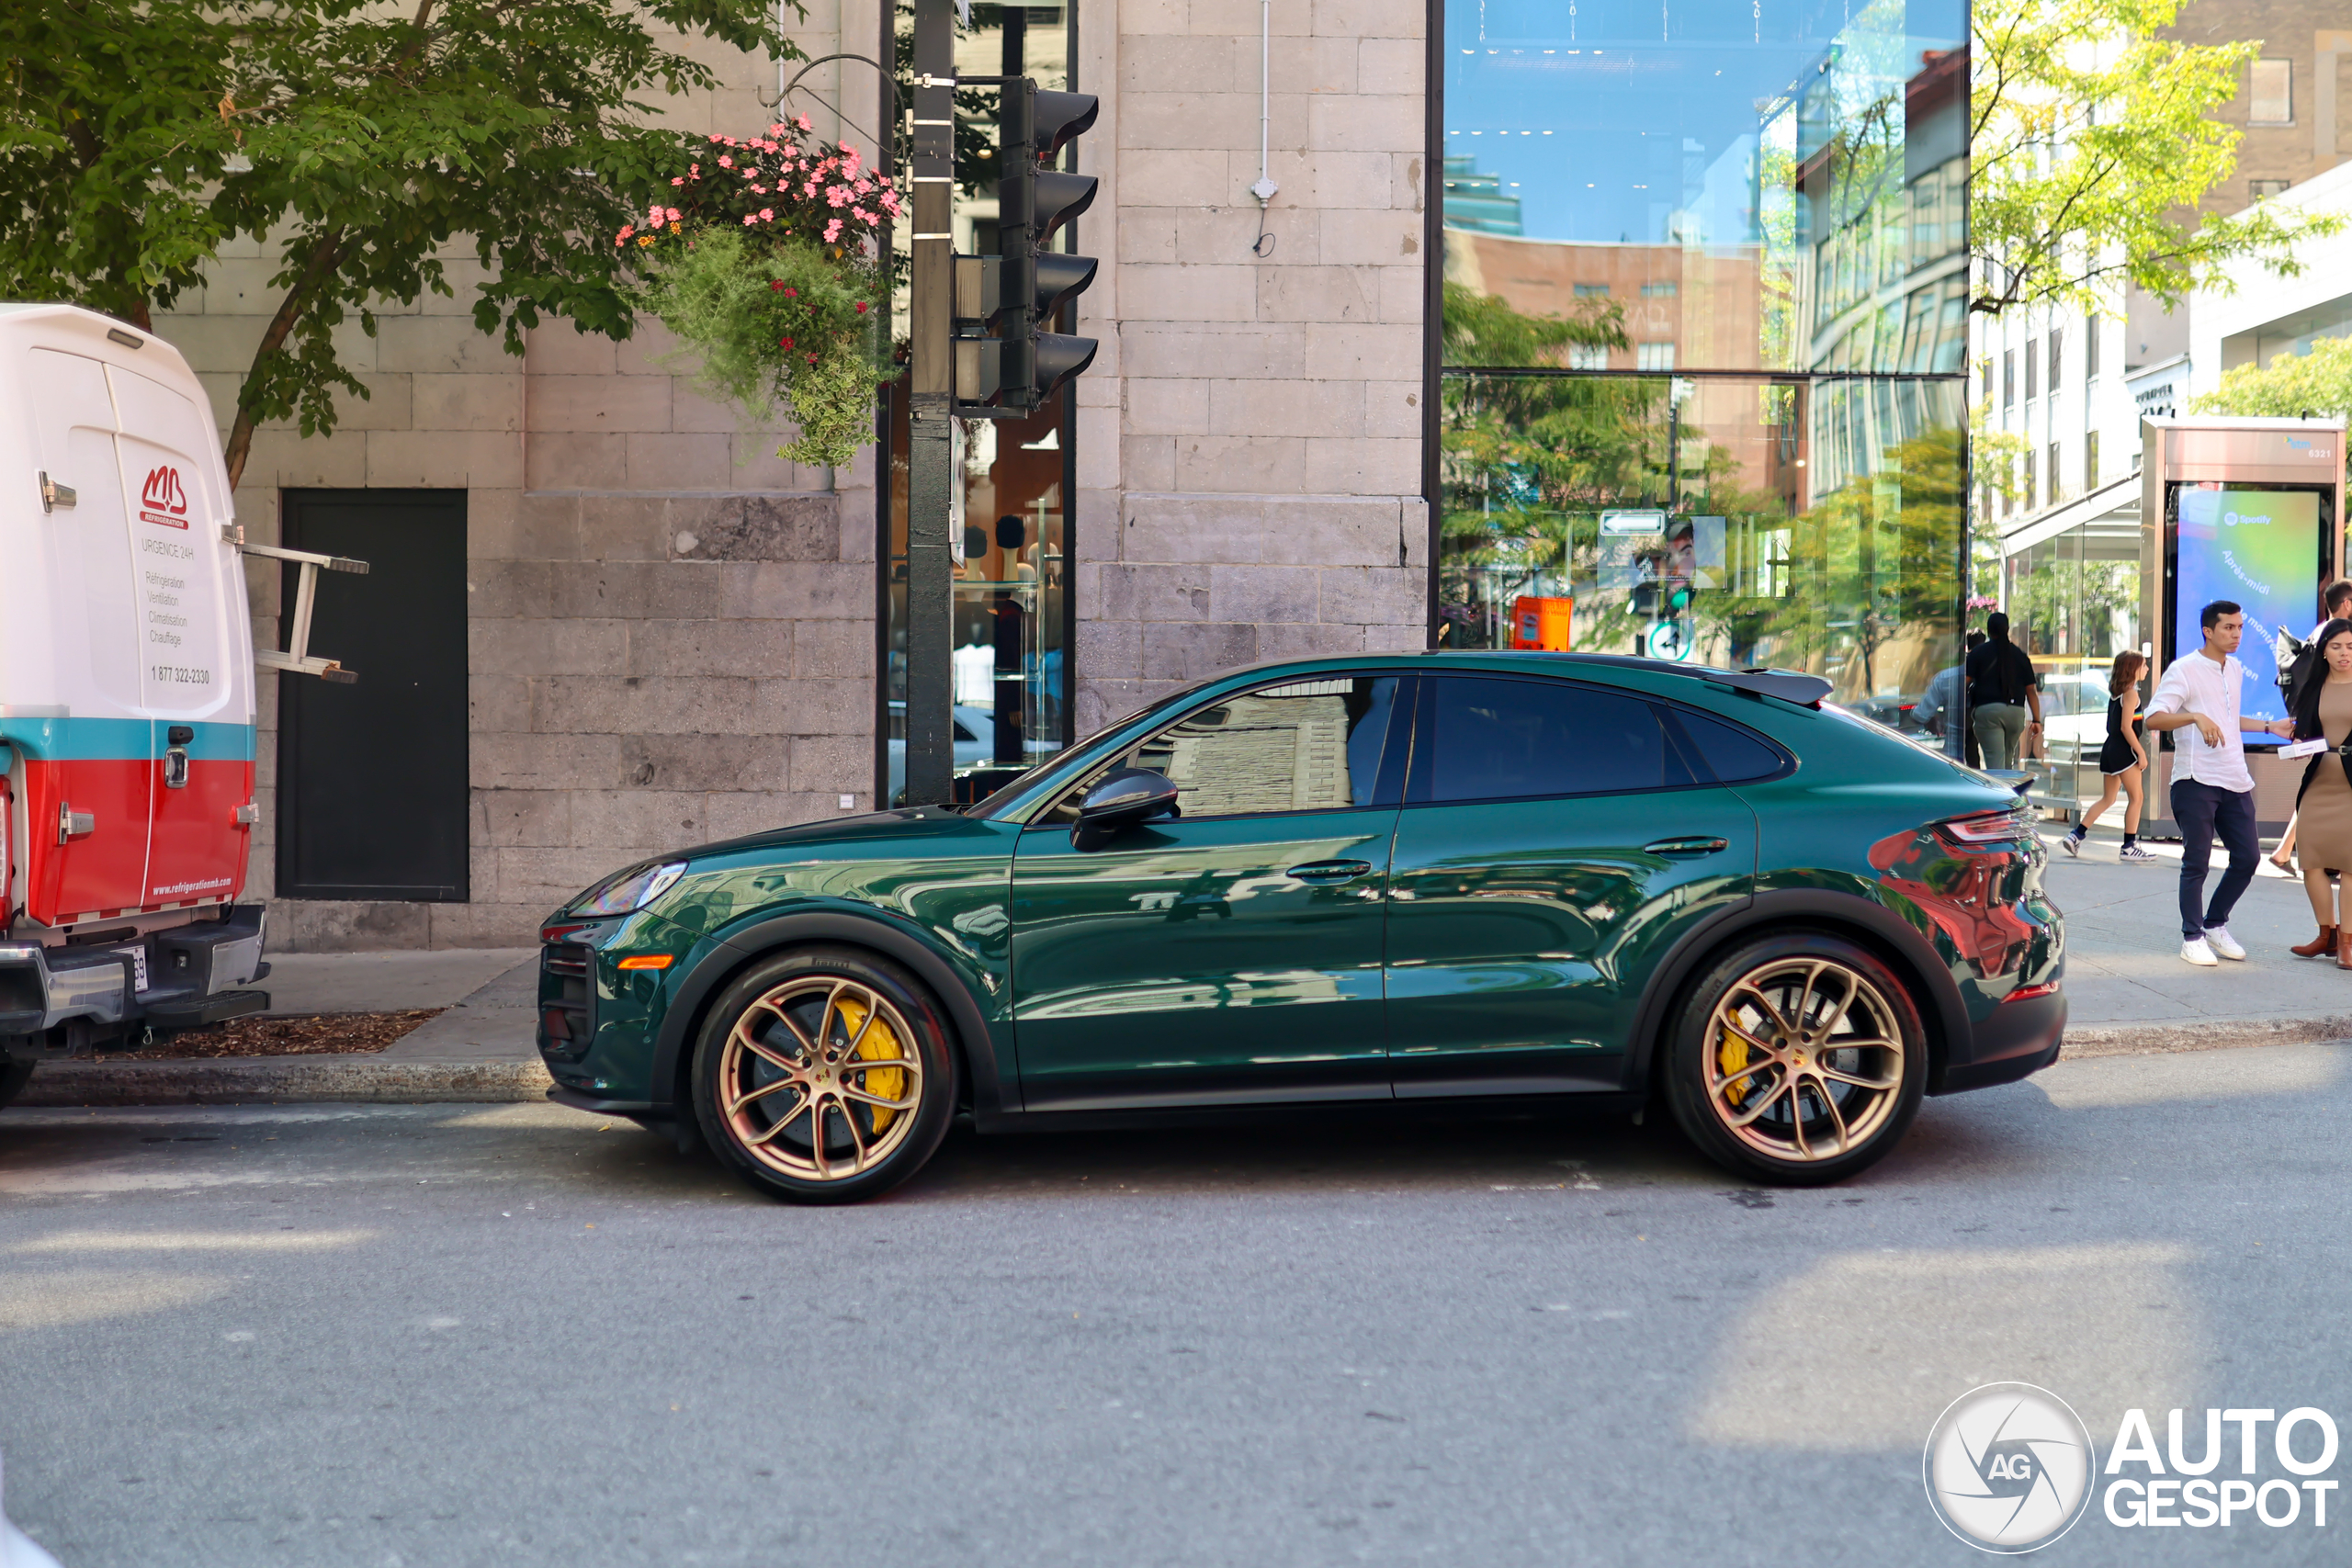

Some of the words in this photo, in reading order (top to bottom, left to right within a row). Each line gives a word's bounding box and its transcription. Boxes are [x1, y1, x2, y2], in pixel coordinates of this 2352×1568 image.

[2290, 440, 2311, 449] stm
[2308, 449, 2331, 458] 6321
[2239, 514, 2272, 525] Spotify
[141, 538, 179, 558] URGENCE
[180, 546, 195, 560] 24H
[145, 570, 186, 591] Réfrigération
[2222, 549, 2271, 596] Après-midi
[146, 590, 179, 607] Ventilation
[148, 610, 187, 627] Climatisation
[150, 629, 182, 649] Chauffage
[152, 664, 156, 681] 1
[158, 665, 173, 682] 877
[175, 667, 209, 685] 322-2330
[153, 877, 232, 896] www.refrigerationmb.com
